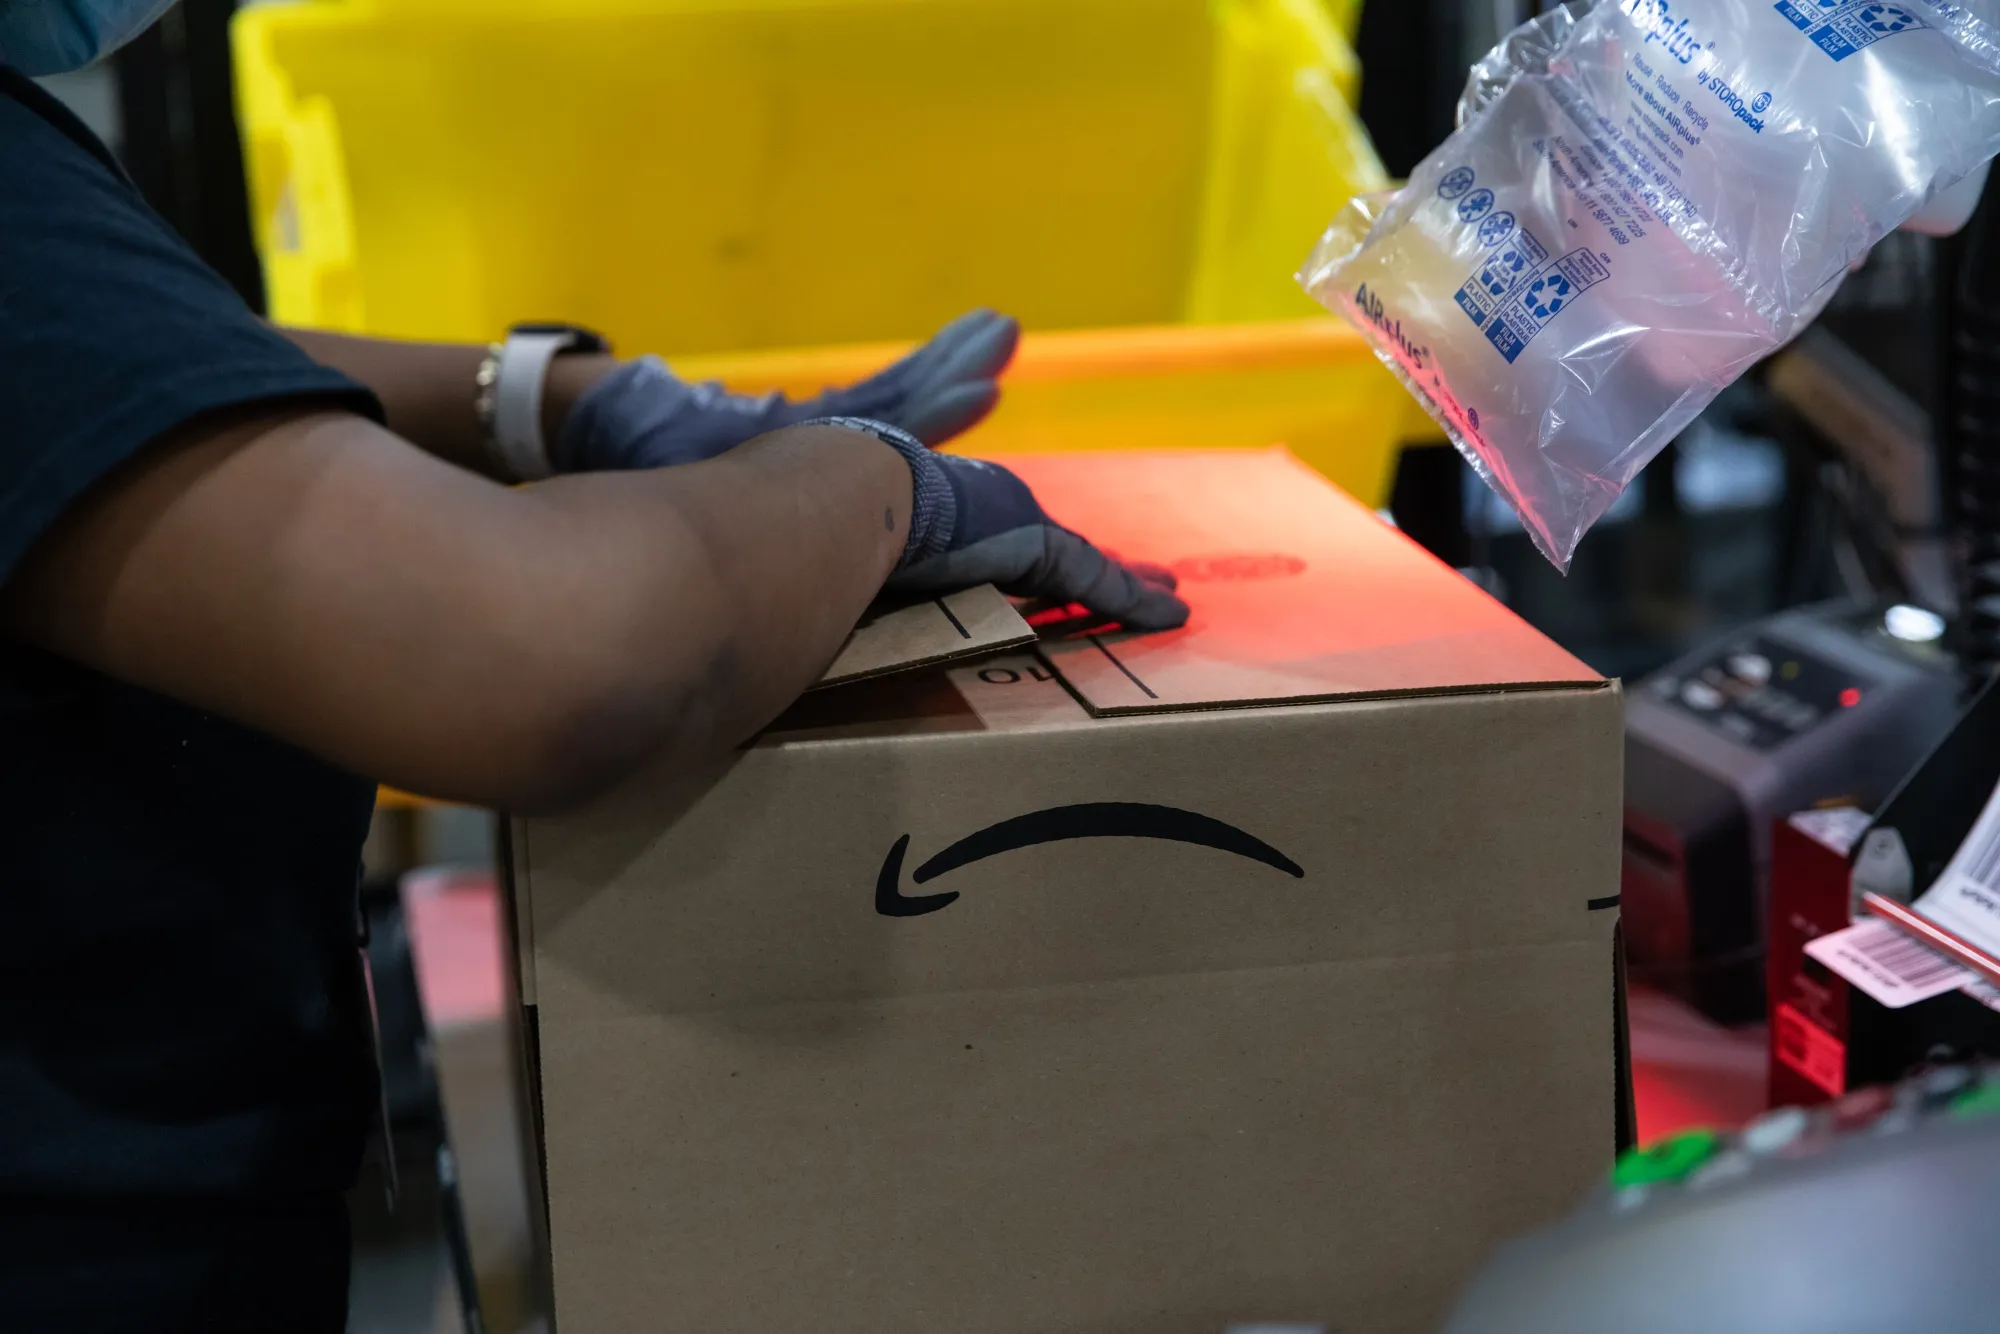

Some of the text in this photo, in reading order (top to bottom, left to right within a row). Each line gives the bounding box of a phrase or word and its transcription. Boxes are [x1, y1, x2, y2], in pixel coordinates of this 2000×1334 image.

[1783, 6, 1802, 23] FILM
[1791, 0, 1819, 22] LASTIC
[1827, 32, 1846, 49] FILM
[1832, 21, 1864, 48] PLASTIQUE
[1841, 16, 1872, 43] PLASTIC
[1819, 37, 1838, 54] FILM
[1632, 53, 1708, 131] Reuse Reduce Recycle
[1644, 91, 1668, 115] about
[1697, 68, 1710, 85] by
[1709, 78, 1765, 133] STOROpack
[1594, 208, 1611, 226] 5677
[1609, 227, 1628, 245] 4699
[1626, 221, 1646, 239] 7225
[1599, 253, 1611, 263] CAN
[1461, 297, 1479, 317] FILM
[1465, 283, 1492, 312] PLASTIC
[1502, 311, 1530, 343] PLASTIQUE
[1509, 305, 1536, 335] PLASTIC
[1493, 334, 1510, 354] FILM
[1499, 326, 1516, 346] FILM
